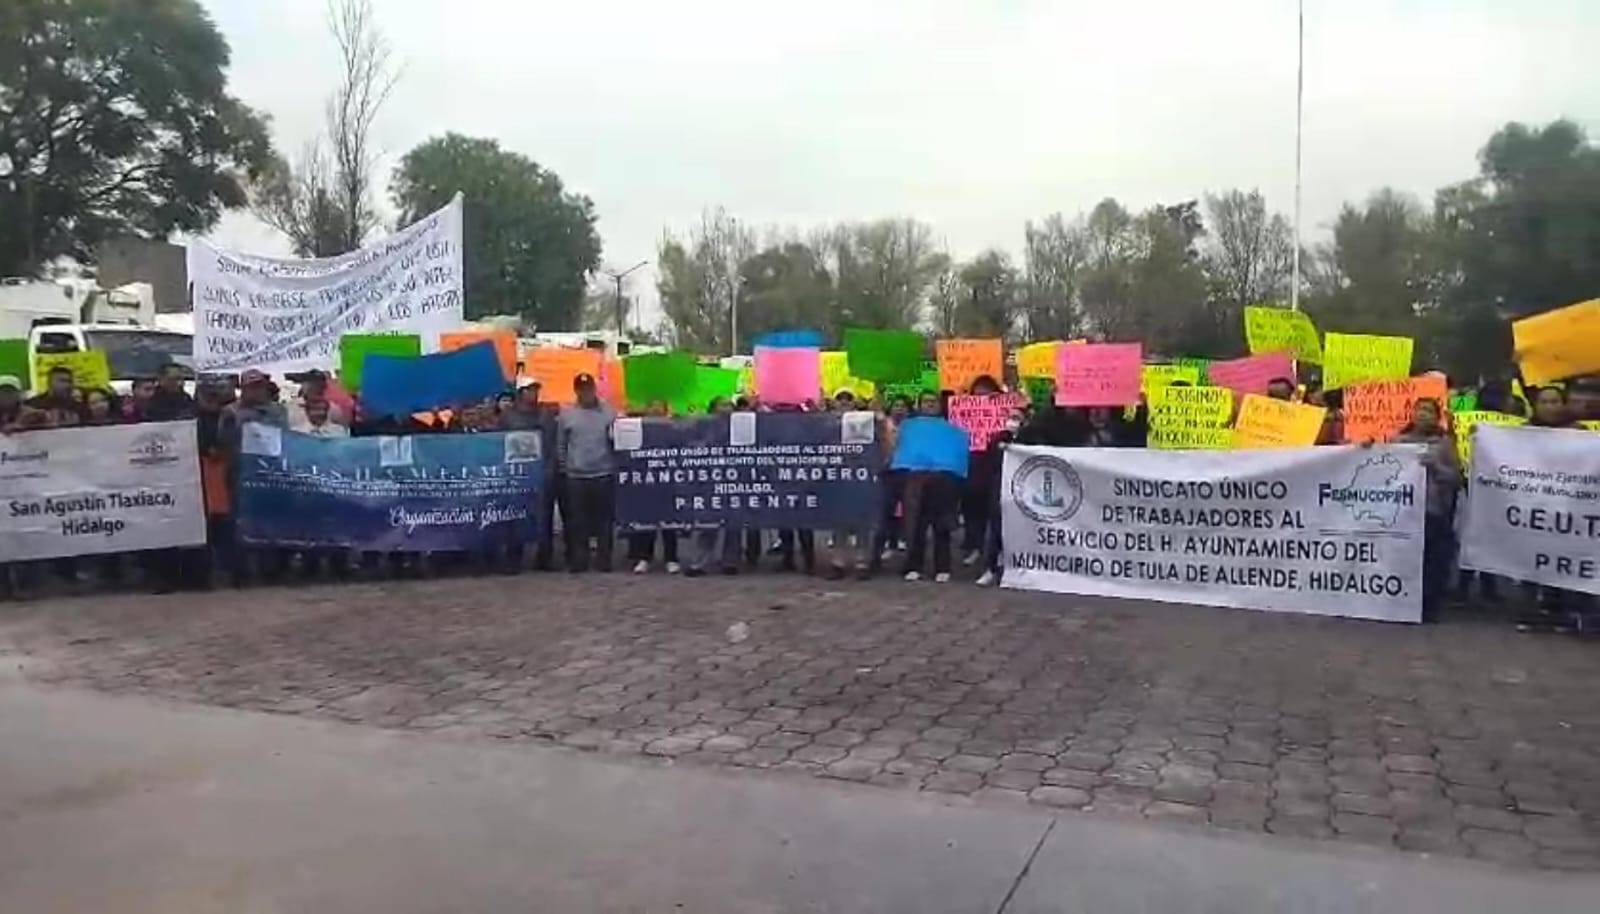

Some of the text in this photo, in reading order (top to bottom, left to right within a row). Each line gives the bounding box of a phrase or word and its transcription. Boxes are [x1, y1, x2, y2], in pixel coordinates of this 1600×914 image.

[802, 444, 816, 454] AL
[818, 443, 864, 454] SERVICIO
[618, 467, 879, 485] FRANCISCO I. MADERO,
[1113, 476, 1288, 500] SINDICATO ÚNICO
[9, 500, 41, 517] San
[675, 494, 819, 510] PRESENTE
[1102, 504, 1305, 529] DE TRABAJADORES AL
[61, 518, 125, 537] Hidalgo
[1037, 527, 1378, 563] SERVICIO DEL H. AYUNTAMIENTO DEL
[1012, 551, 1409, 598] MUNICIPIO DE TULA DE ALLENDE, HIDALGO.
